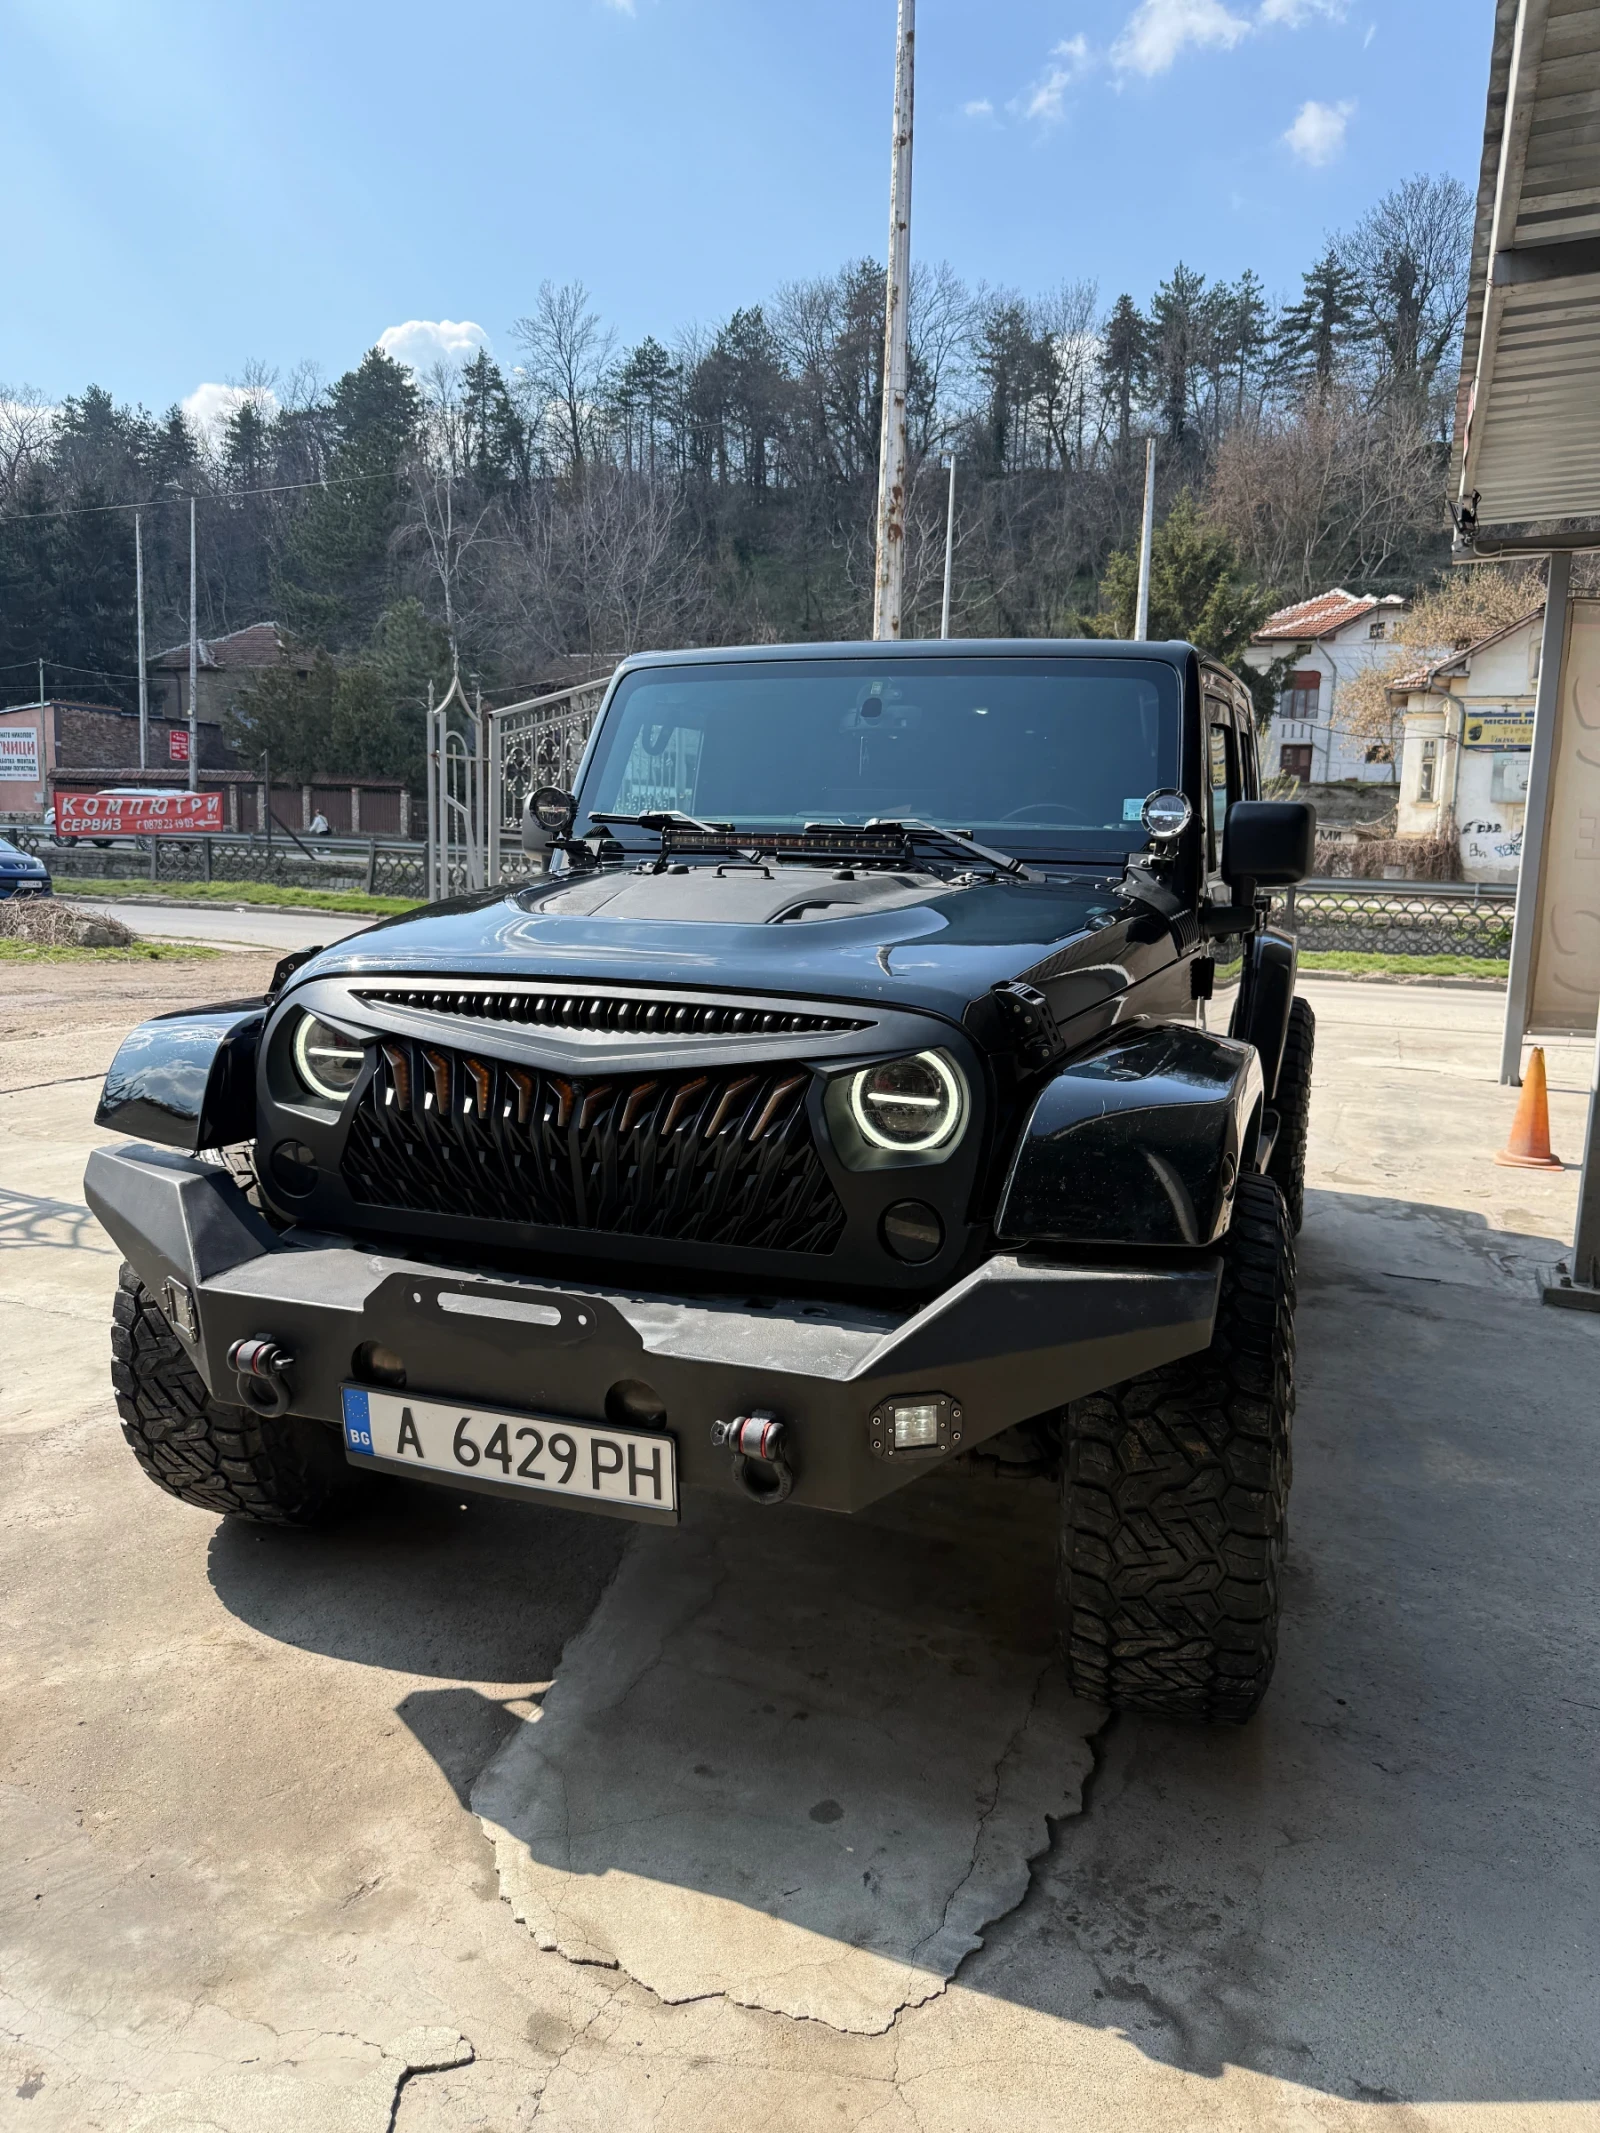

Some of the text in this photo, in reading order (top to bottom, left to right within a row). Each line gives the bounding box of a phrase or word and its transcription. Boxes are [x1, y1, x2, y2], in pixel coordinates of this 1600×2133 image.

[61, 797, 219, 816] КОМПЮТРИ
[60, 817, 122, 832] СЕРВИЗ
[350, 1428, 370, 1446] BG
[396, 1406, 663, 1500] A 6429 PH
